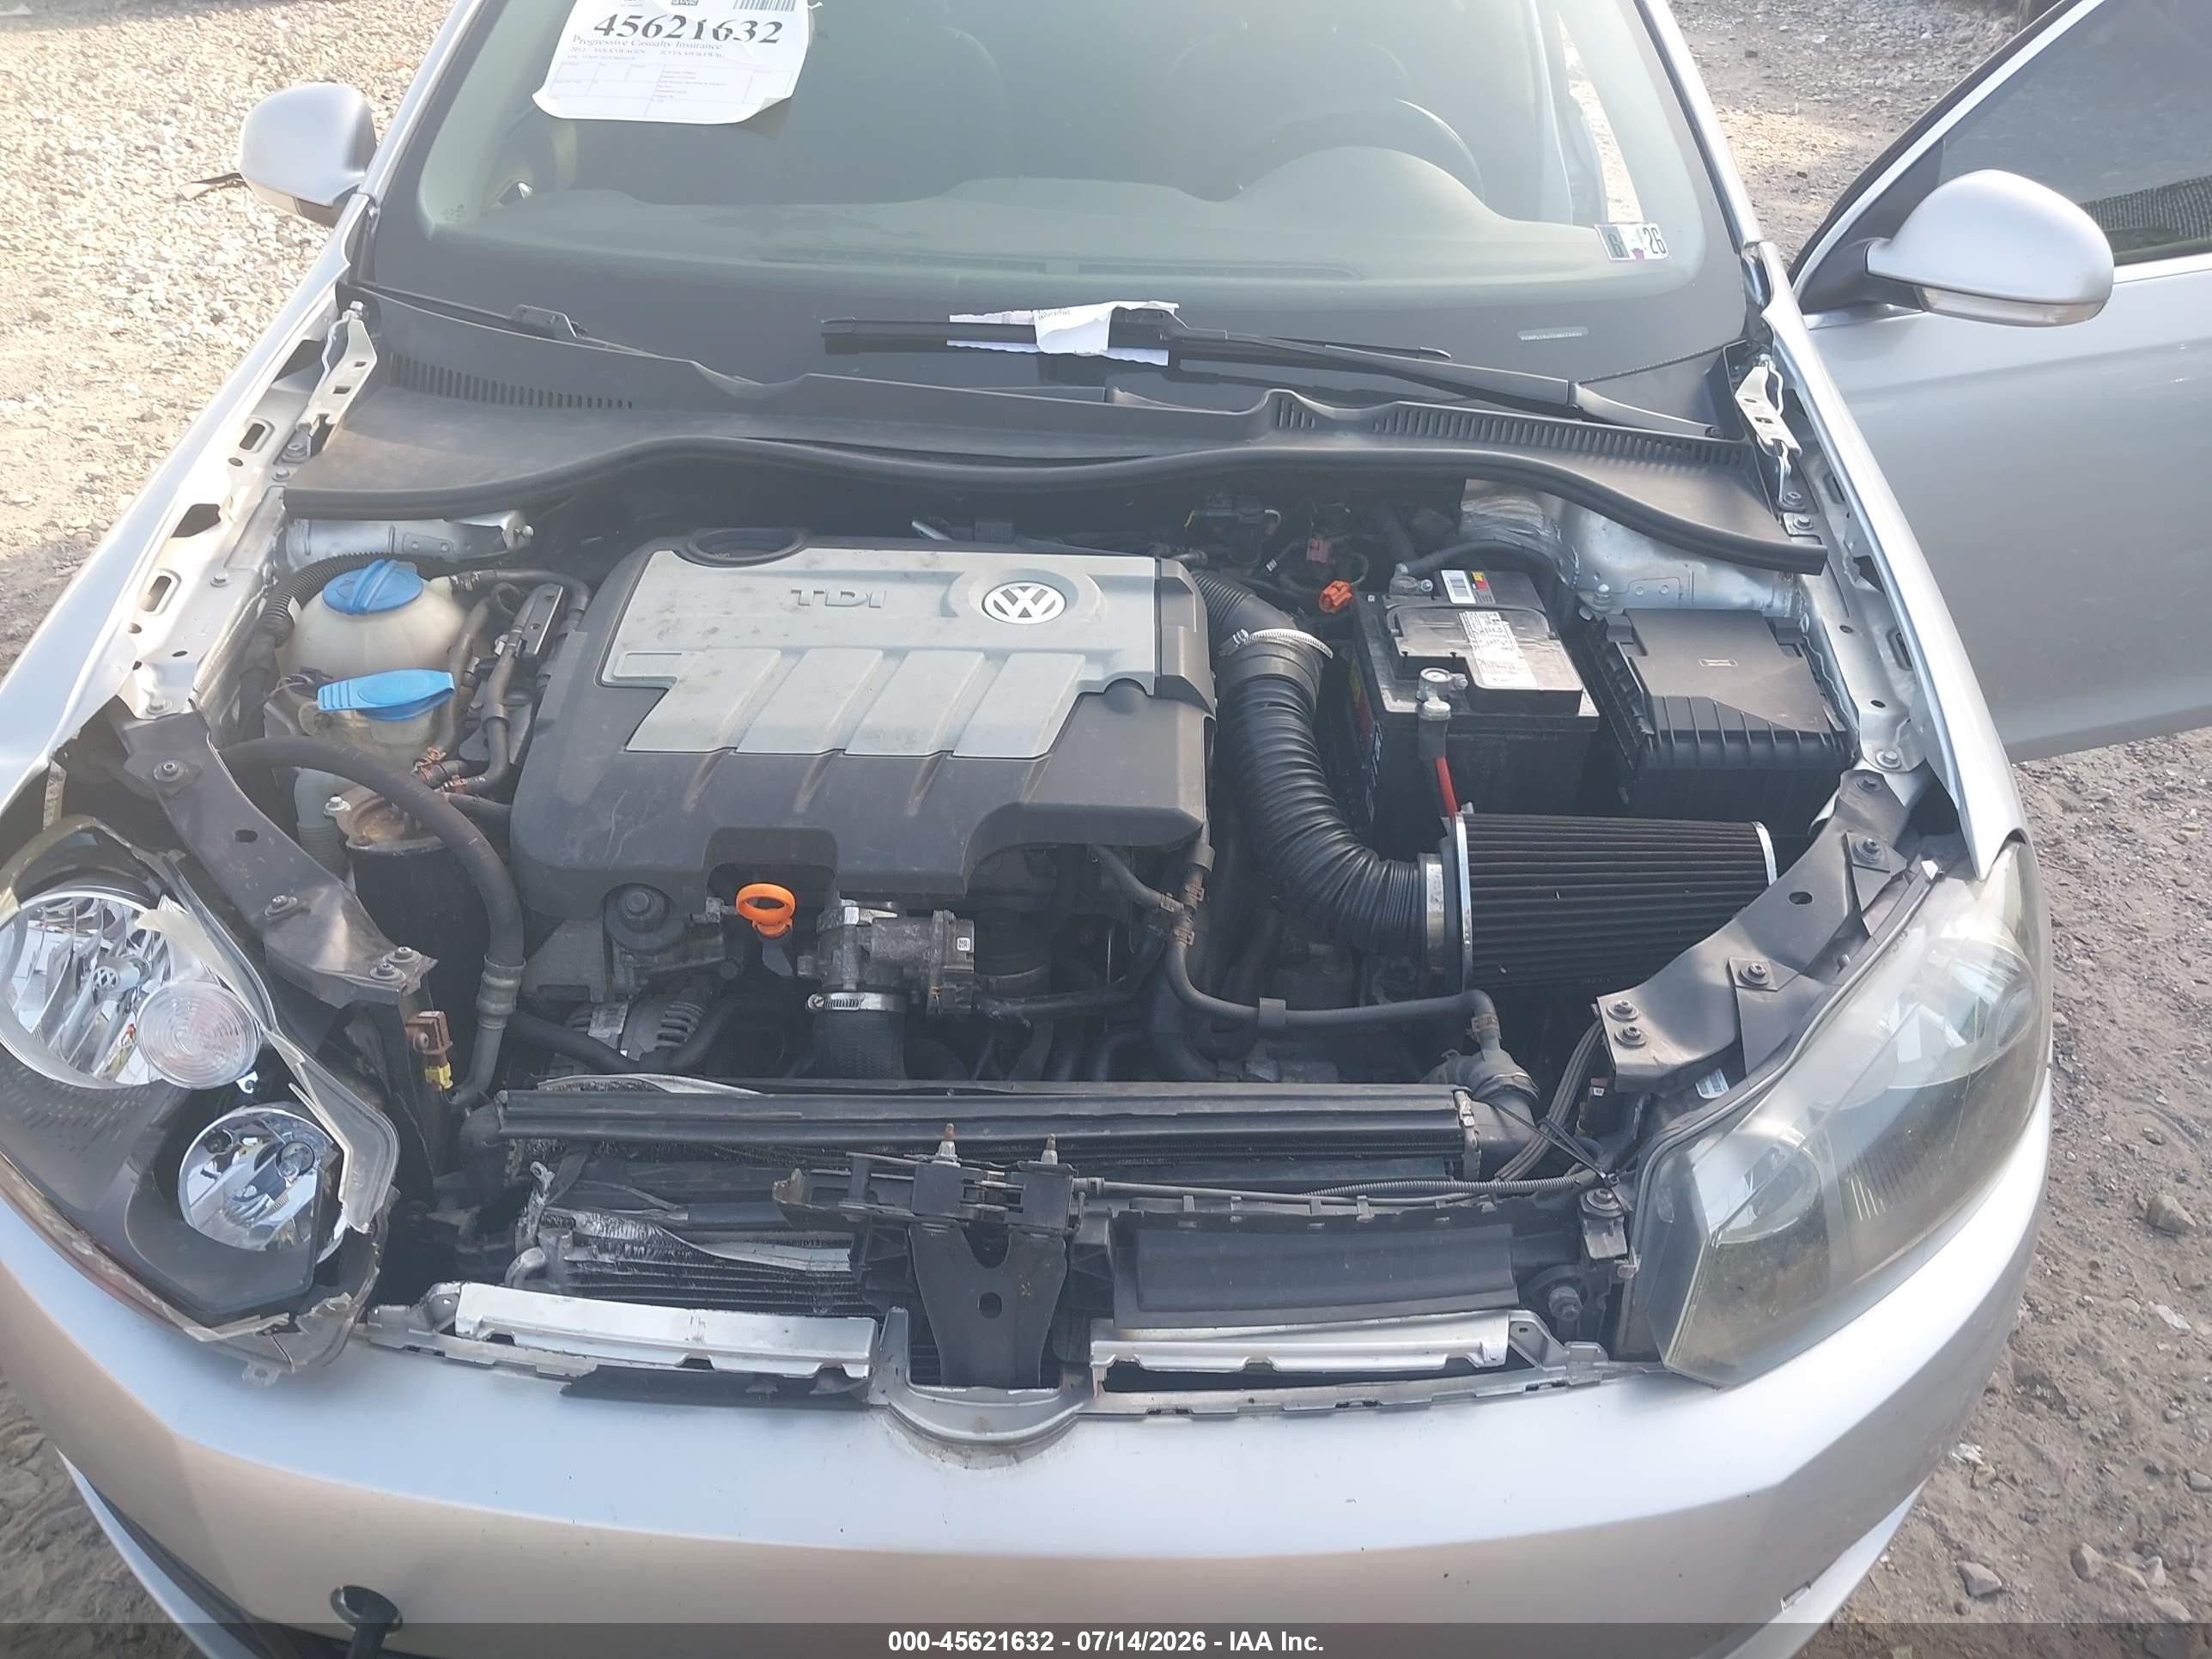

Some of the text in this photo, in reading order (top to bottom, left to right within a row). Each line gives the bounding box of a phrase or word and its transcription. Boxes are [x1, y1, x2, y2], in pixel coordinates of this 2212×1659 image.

[573, 34, 722, 50] Progressive Casualty Insurance
[594, 13, 783, 44] 45621632
[1643, 227, 1667, 255] 26
[790, 587, 886, 608] TDI
[982, 581, 1066, 625] VW
